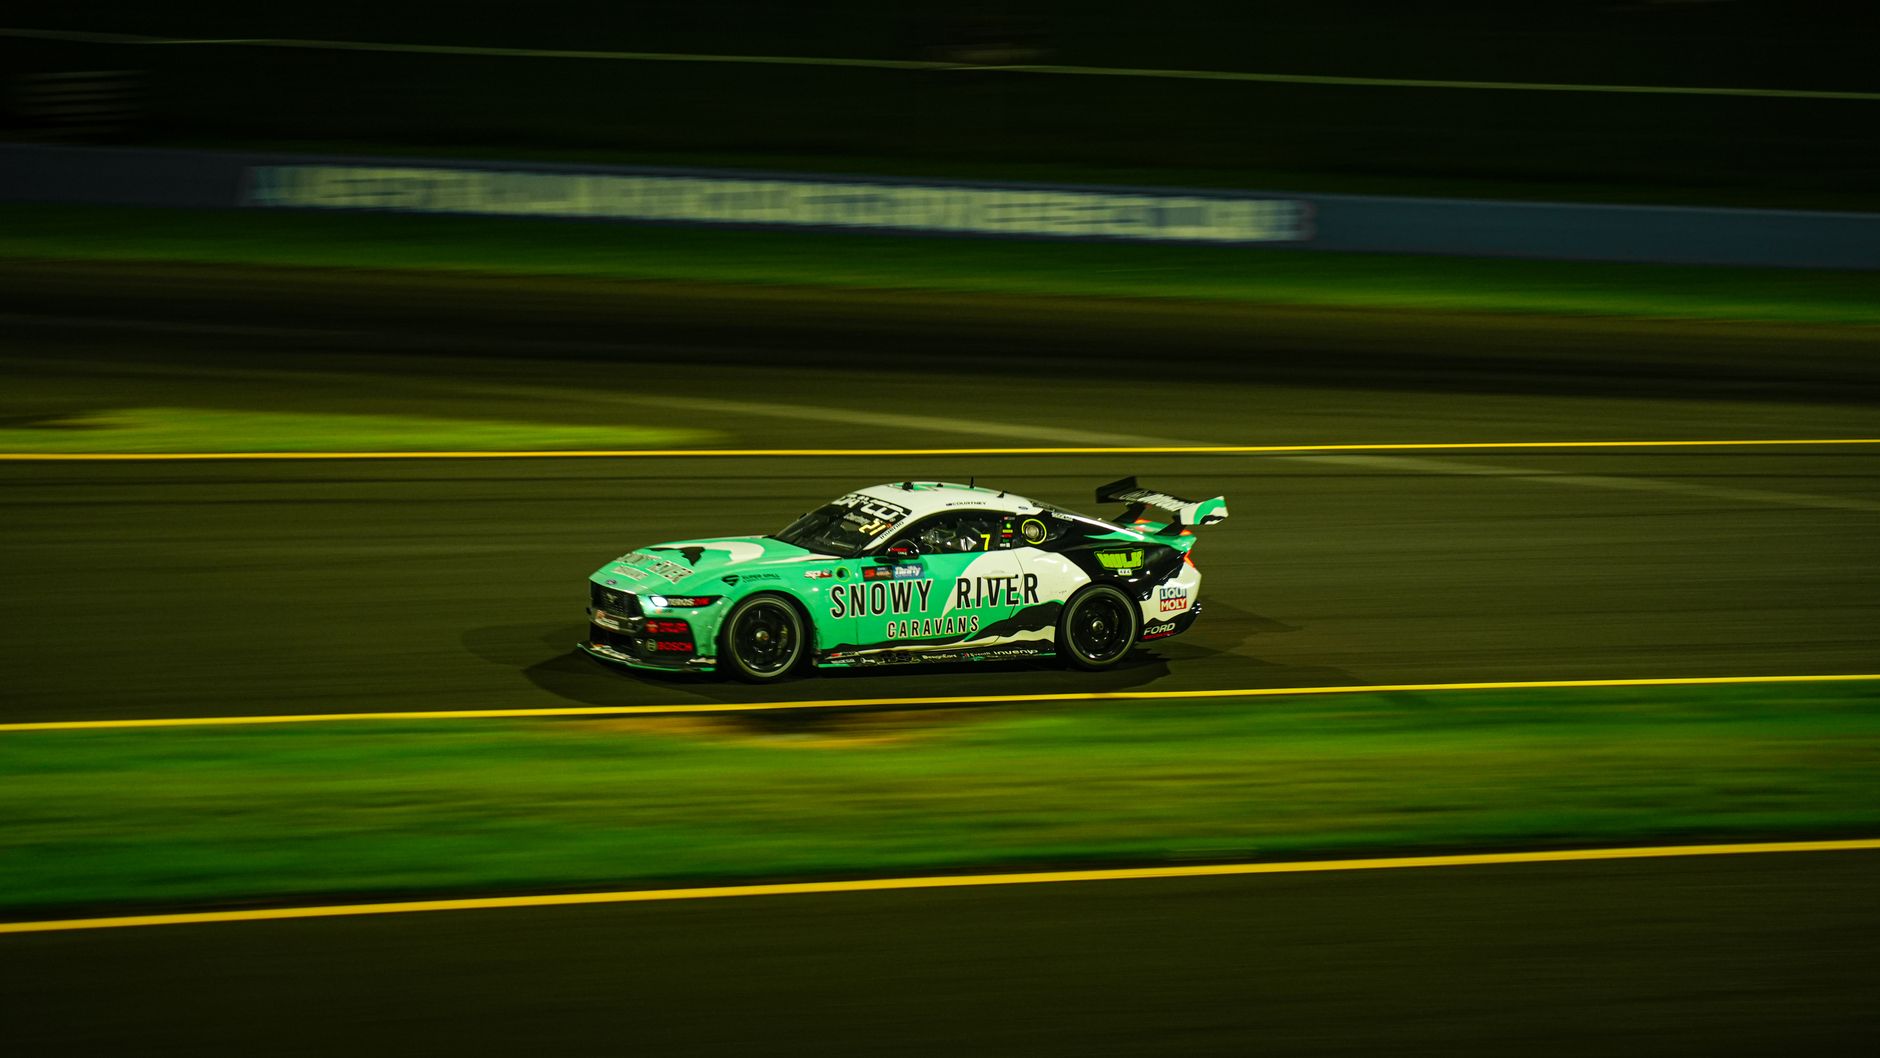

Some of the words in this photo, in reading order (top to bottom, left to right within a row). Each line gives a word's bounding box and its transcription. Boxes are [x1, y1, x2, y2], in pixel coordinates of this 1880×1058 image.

[980, 533, 991, 551] 7
[1096, 550, 1143, 568] HULK
[830, 579, 932, 619] SNOWY
[956, 573, 1040, 610] RIVER
[1160, 587, 1187, 599] LIQUI
[1160, 599, 1187, 611] MOLY
[886, 615, 980, 640] CARAVANS
[1143, 622, 1176, 636] FORD
[657, 641, 693, 652] BOSCH
